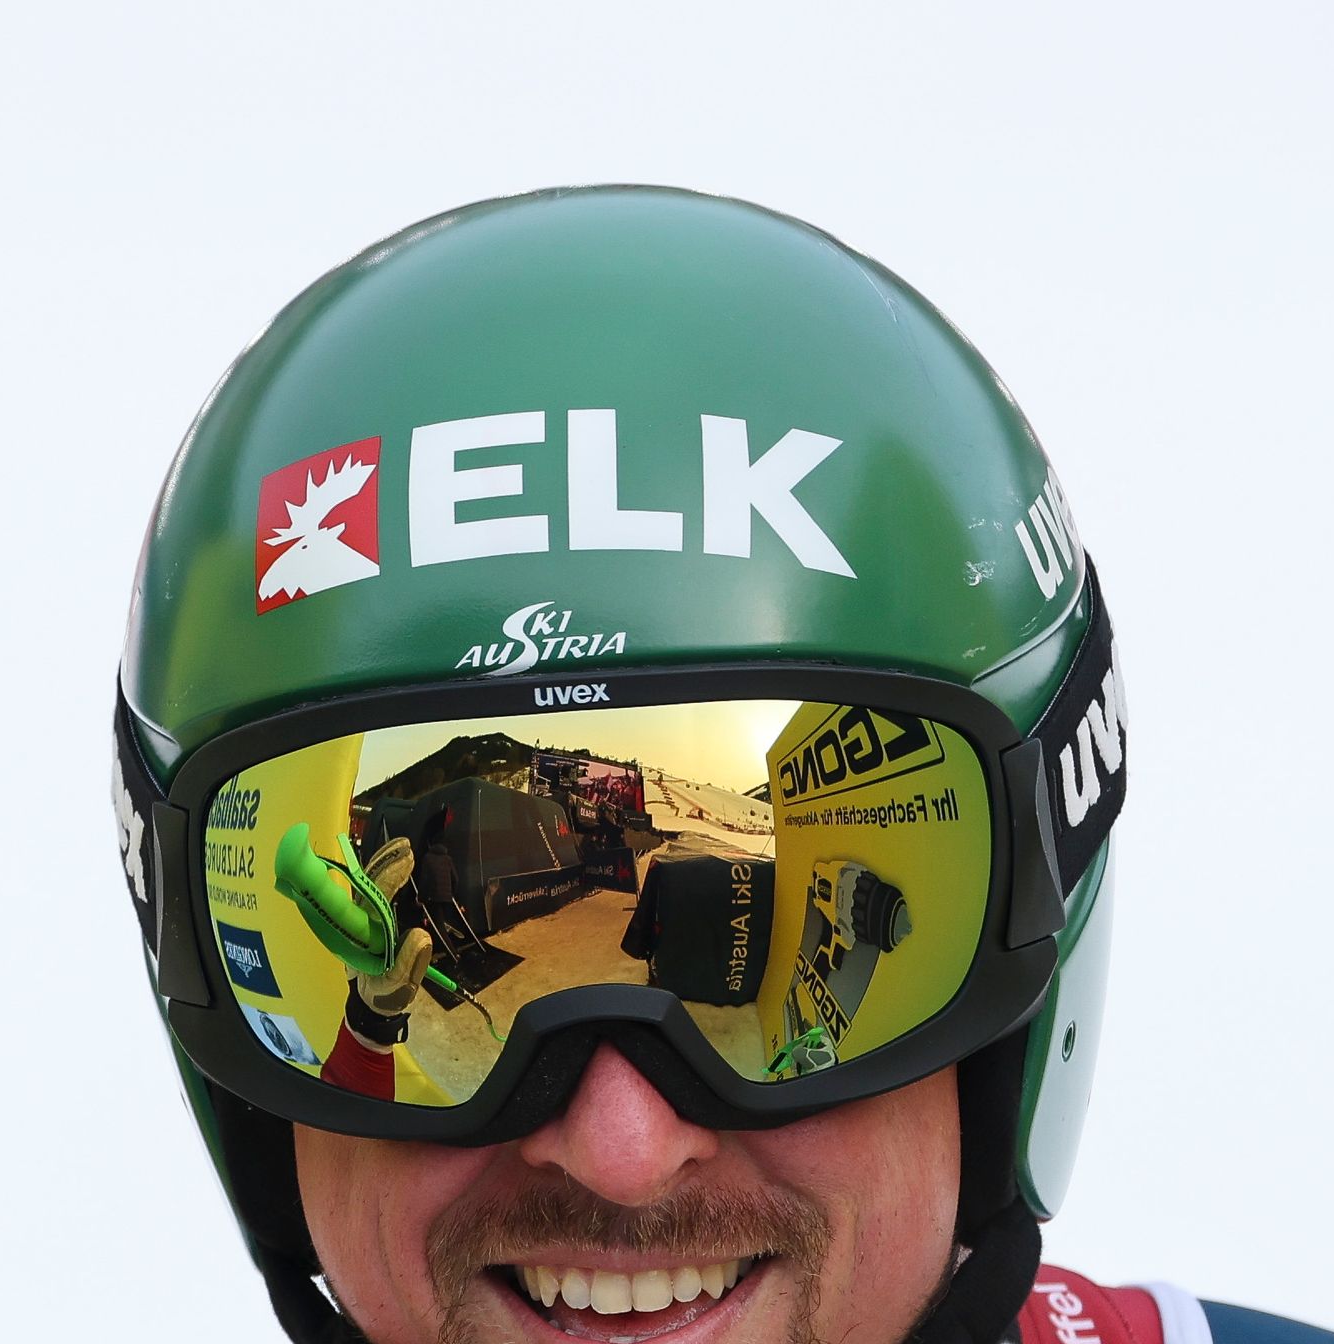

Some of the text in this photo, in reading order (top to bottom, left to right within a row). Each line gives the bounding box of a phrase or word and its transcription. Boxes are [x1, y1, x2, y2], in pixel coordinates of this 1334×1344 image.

[408, 408, 857, 579] ELK
[455, 630, 627, 676] AUSTRIA
[534, 683, 611, 707] uvex
